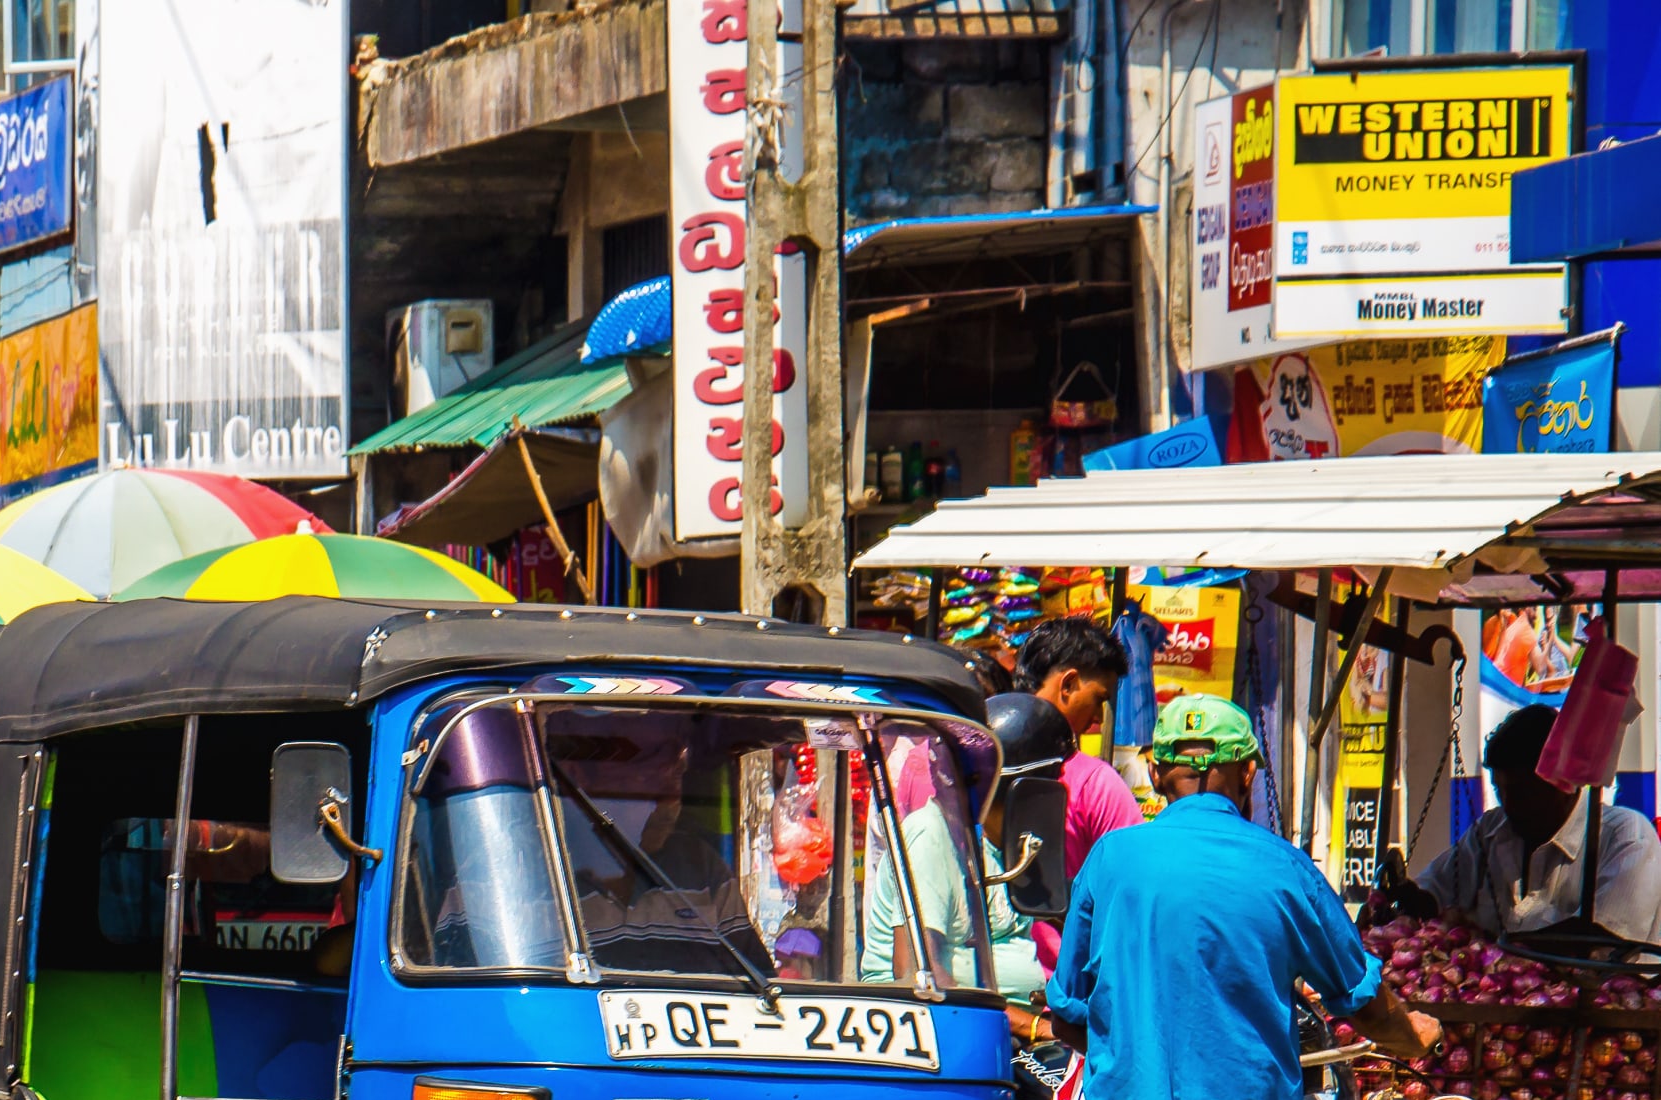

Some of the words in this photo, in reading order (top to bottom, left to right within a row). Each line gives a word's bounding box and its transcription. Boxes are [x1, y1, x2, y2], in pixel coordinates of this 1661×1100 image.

[1298, 99, 1508, 135] WESTERN
[1362, 129, 1508, 161] UNION
[1335, 173, 1415, 193] MONEY
[1424, 171, 1511, 190] TRANSF
[1357, 298, 1417, 320] Money
[1422, 297, 1484, 319] Master
[106, 422, 155, 466] Lu
[164, 418, 213, 465] Lu
[223, 414, 341, 464] Centre
[1155, 439, 1200, 462] ROZA
[665, 1001, 741, 1049] QE
[798, 1005, 931, 1060] 2491
[1010, 1049, 1063, 1092] pulsa
